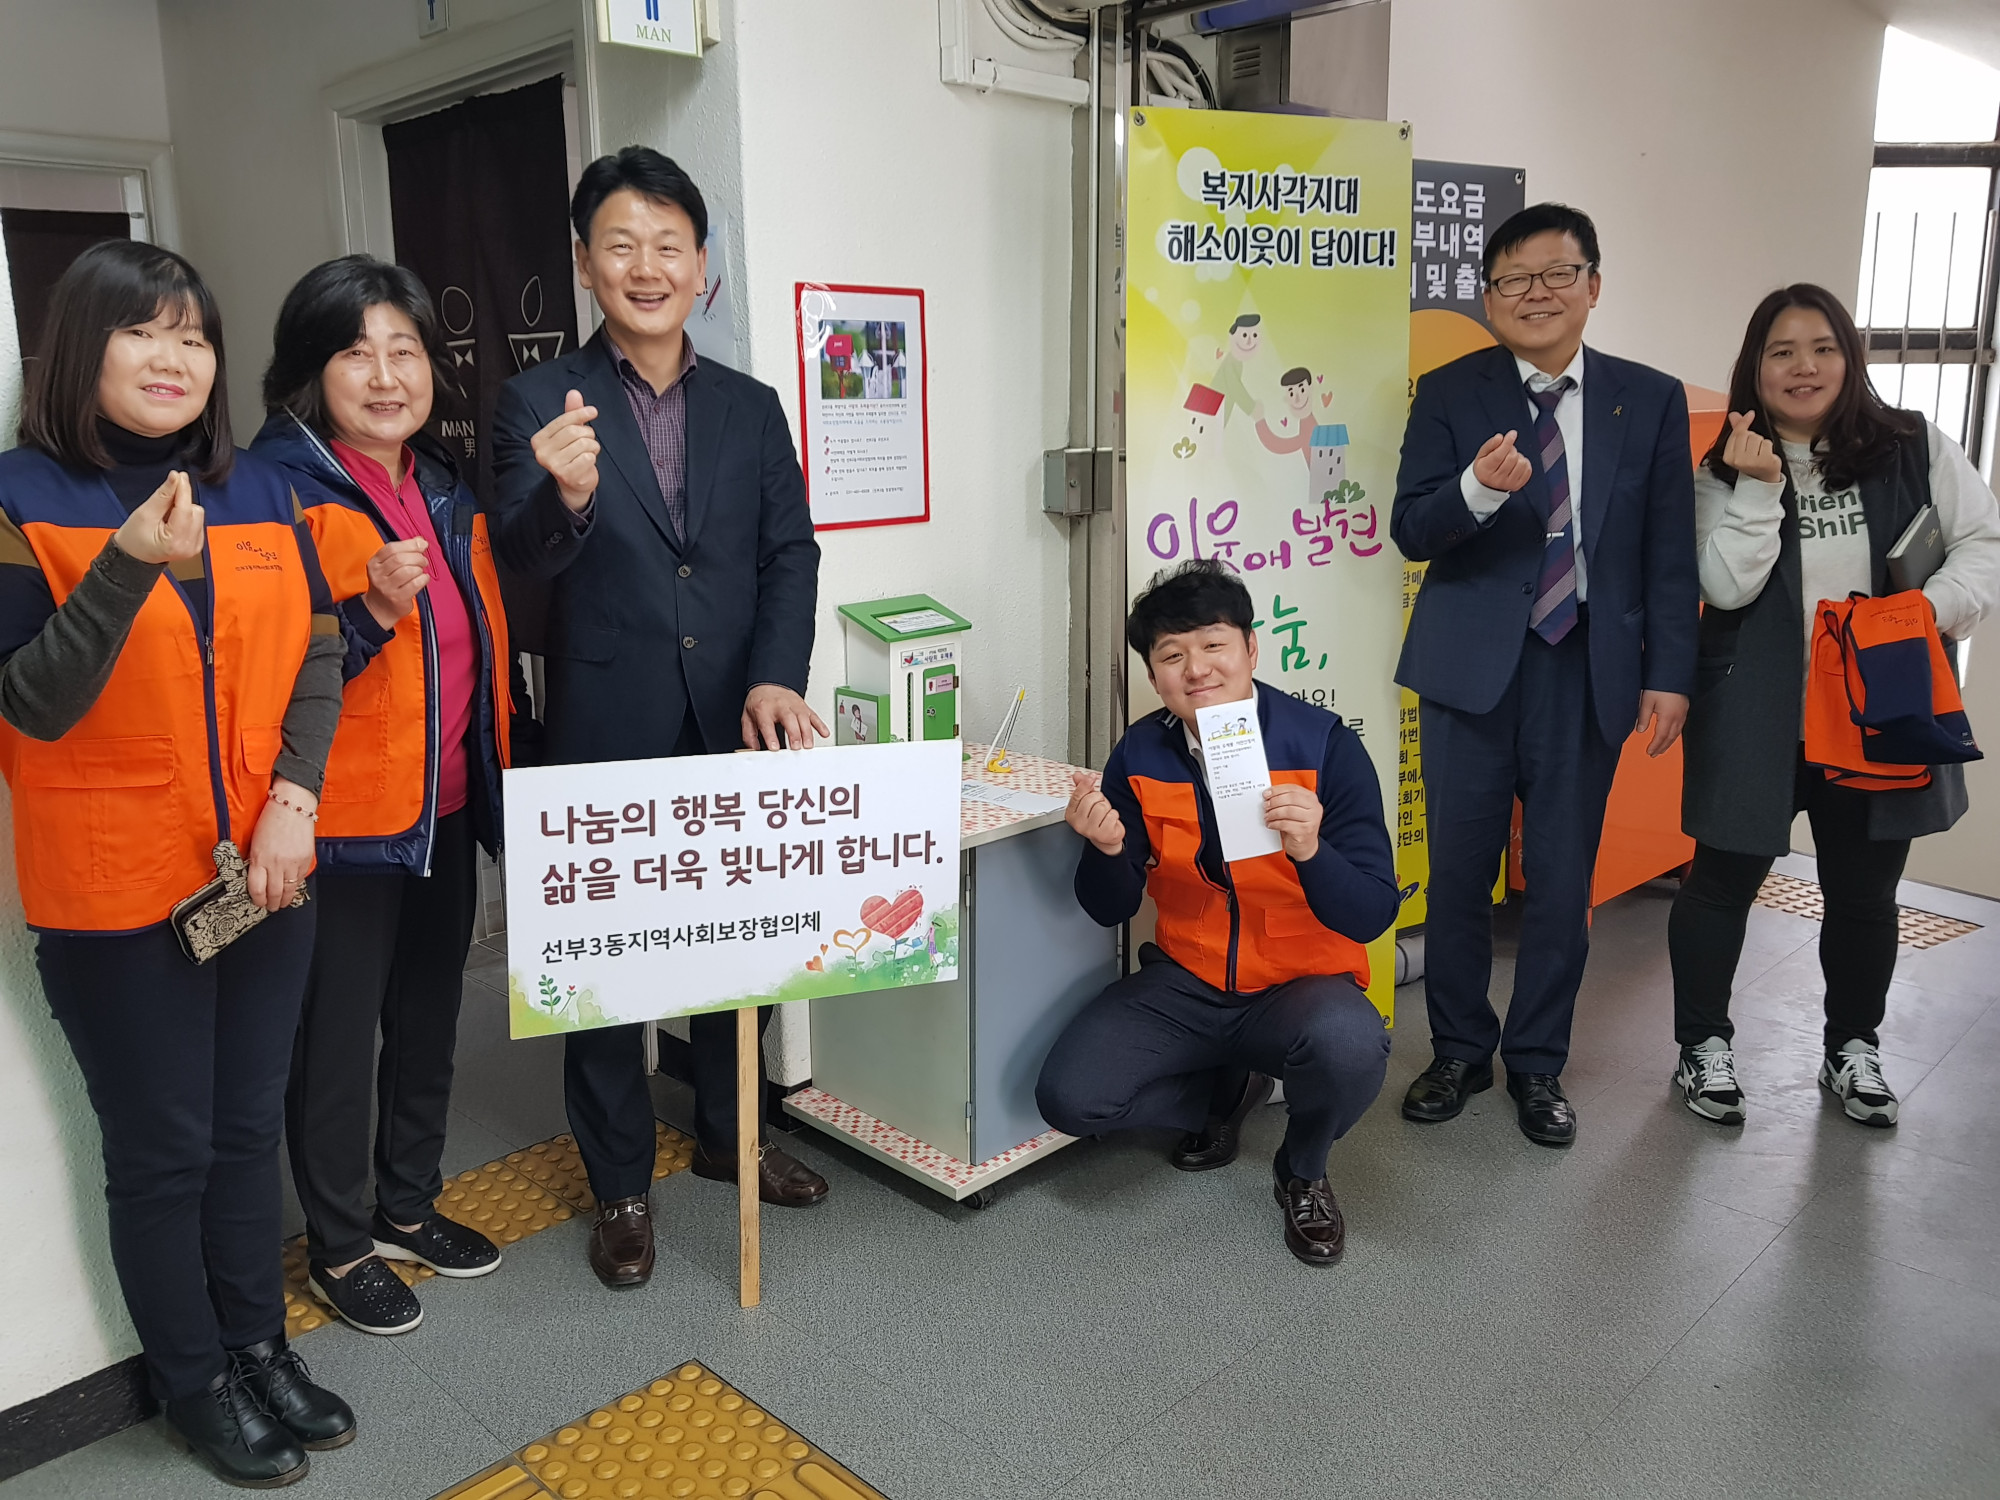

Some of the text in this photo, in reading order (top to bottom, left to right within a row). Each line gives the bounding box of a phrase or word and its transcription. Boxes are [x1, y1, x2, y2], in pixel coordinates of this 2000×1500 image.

[635, 24, 671, 43] MAN
[1201, 170, 1360, 213] 복지사각지대
[1167, 223, 1301, 266] 해소이웃이
[1311, 229, 1395, 268] 답이다!
[1412, 220, 1484, 260] 부내역
[1426, 262, 1447, 300] 및
[1455, 262, 1488, 300] 출
[441, 419, 475, 437] MAN
[464, 437, 476, 459] 男
[1794, 490, 1858, 513] rien
[1291, 497, 1383, 567] 발견
[1798, 511, 1868, 539] ShiP
[1250, 594, 1328, 673] 눔,
[540, 783, 861, 845] 나눔의 행복 당신의
[541, 829, 944, 906] 삶을 더욱 빛나게 합니다.
[541, 909, 822, 964] 선부3동지역사회보장협의체
